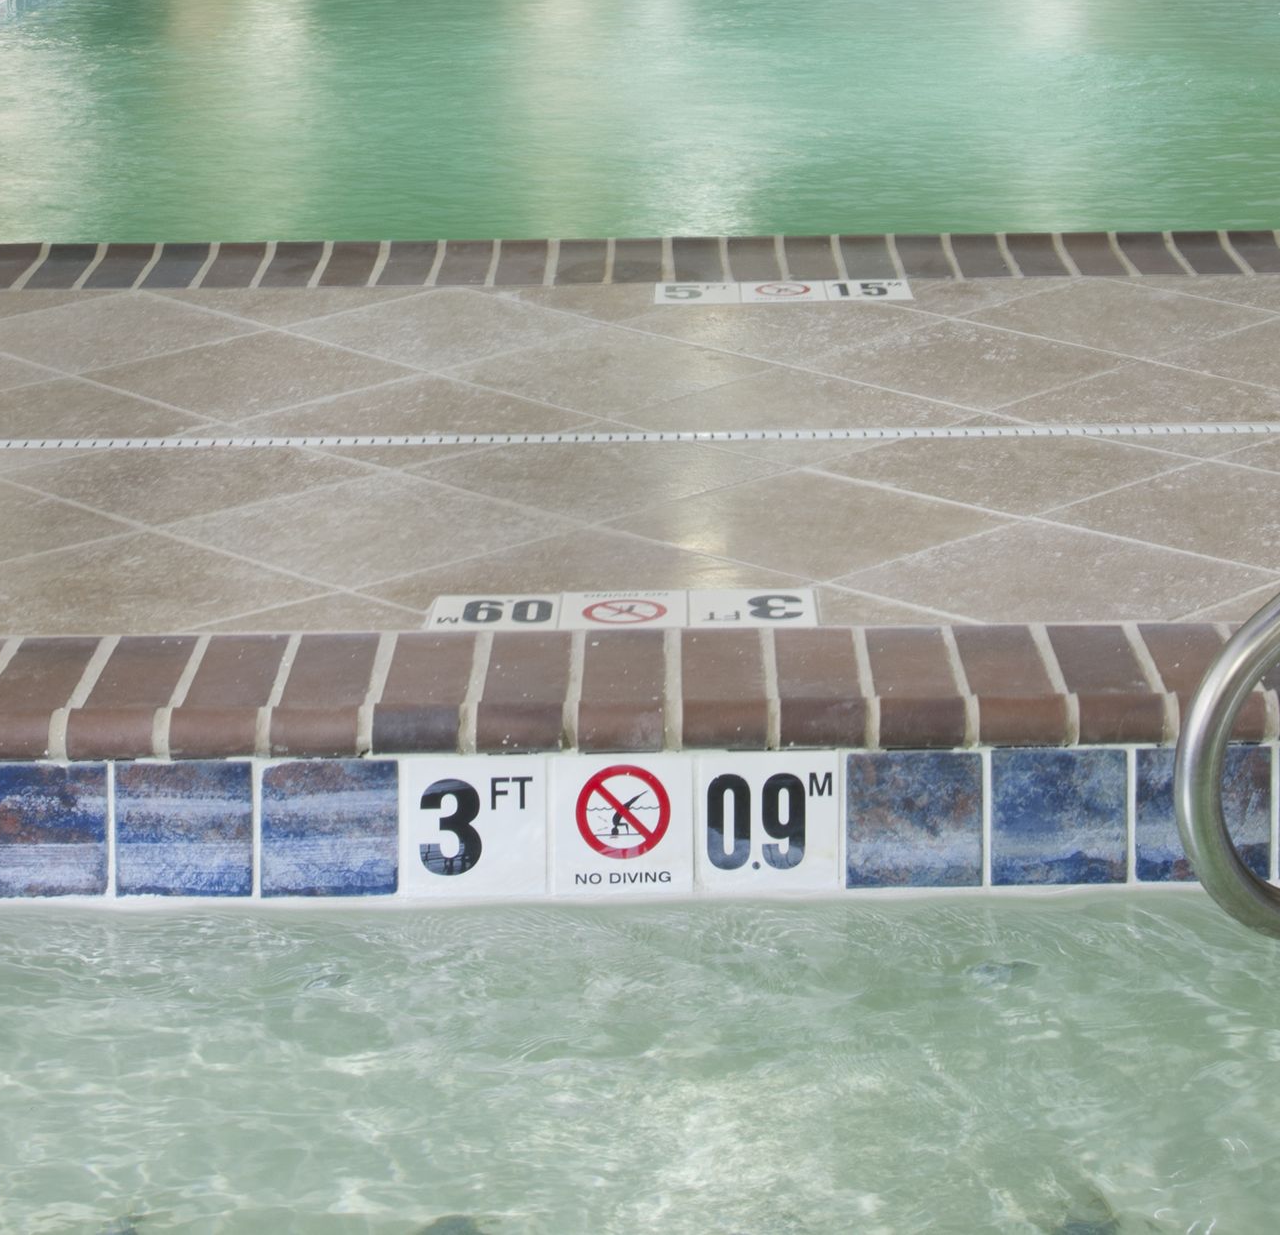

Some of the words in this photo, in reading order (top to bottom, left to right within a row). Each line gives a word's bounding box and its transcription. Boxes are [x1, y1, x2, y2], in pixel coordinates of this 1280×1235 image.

[664, 284, 703, 300] 5
[746, 594, 804, 620] 3
[419, 778, 483, 877] 3
[489, 775, 534, 811] FT
[574, 872, 606, 886] NO
[608, 870, 672, 885] DIVING
